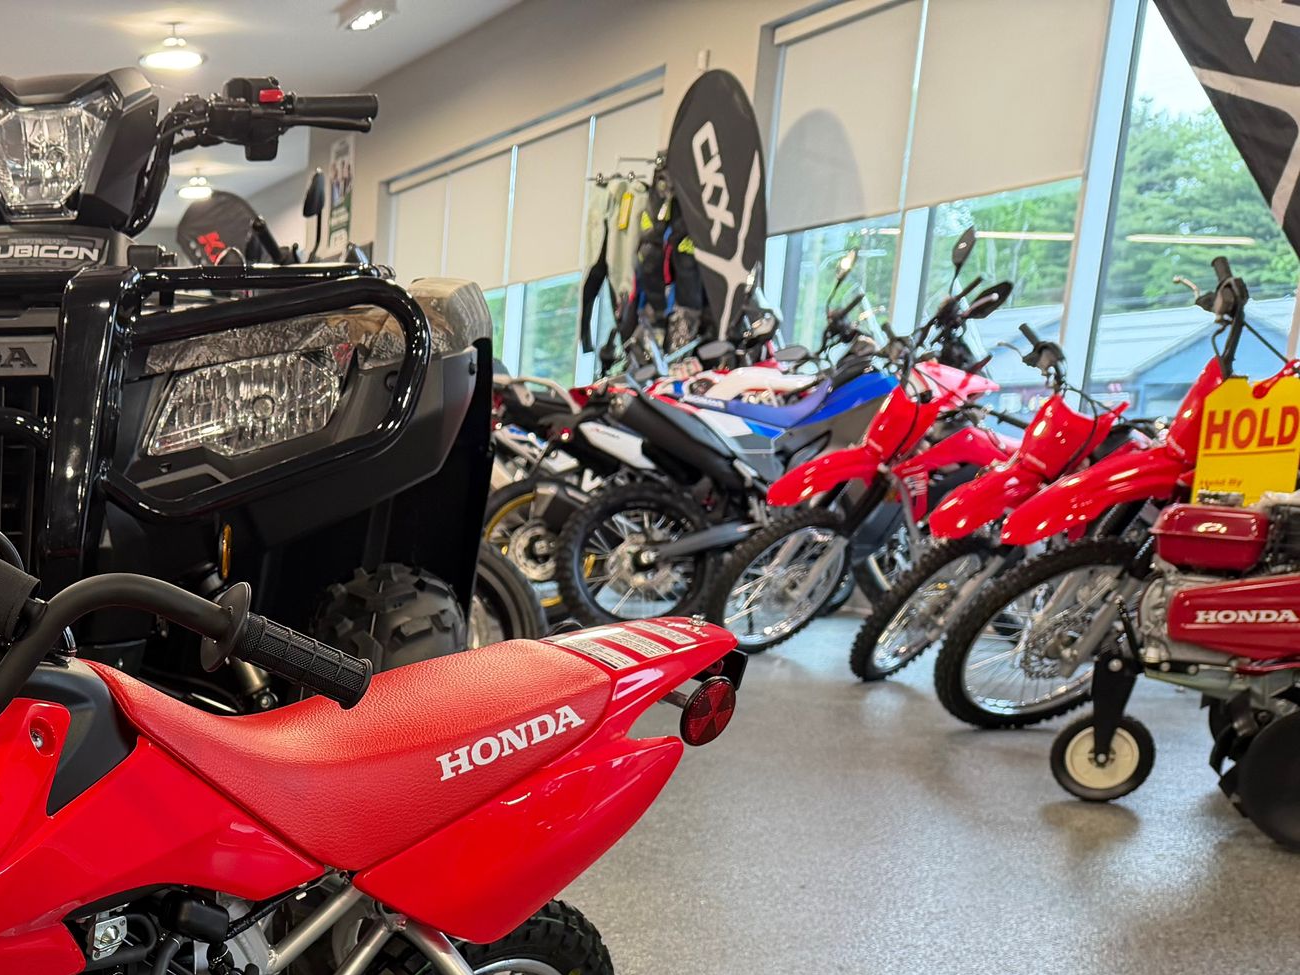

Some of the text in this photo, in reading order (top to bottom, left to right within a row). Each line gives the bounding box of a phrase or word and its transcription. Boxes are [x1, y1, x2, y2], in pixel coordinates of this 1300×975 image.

[1203, 406, 1300, 449] HOLD
[1195, 609, 1300, 623] HONDA
[435, 705, 586, 781] HONDA
